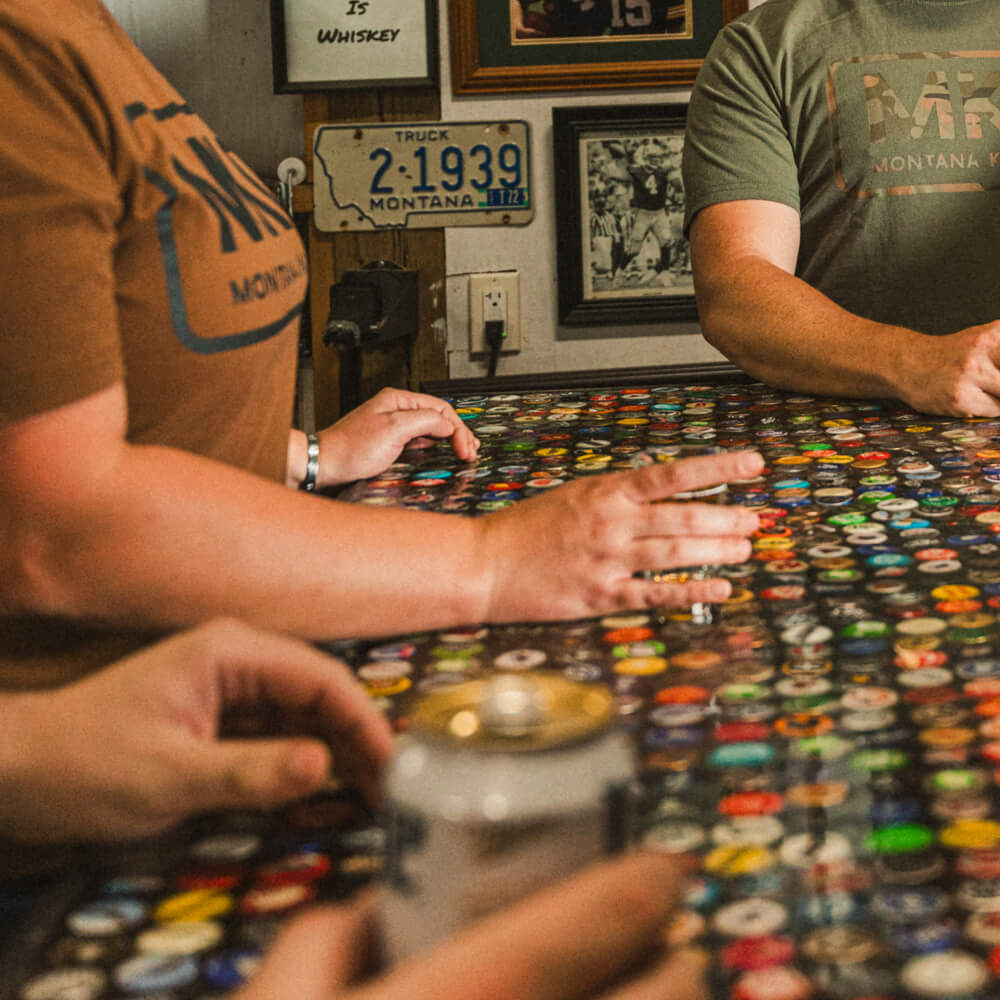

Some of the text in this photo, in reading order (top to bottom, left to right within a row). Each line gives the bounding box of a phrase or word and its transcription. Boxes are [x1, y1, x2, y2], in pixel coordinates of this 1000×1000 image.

[345, 0, 370, 16] IS
[316, 28, 401, 44] WHISKEY
[394, 130, 450, 143] TRUCK
[875, 152, 981, 173] MONTANA
[369, 194, 475, 211] MONTANA
